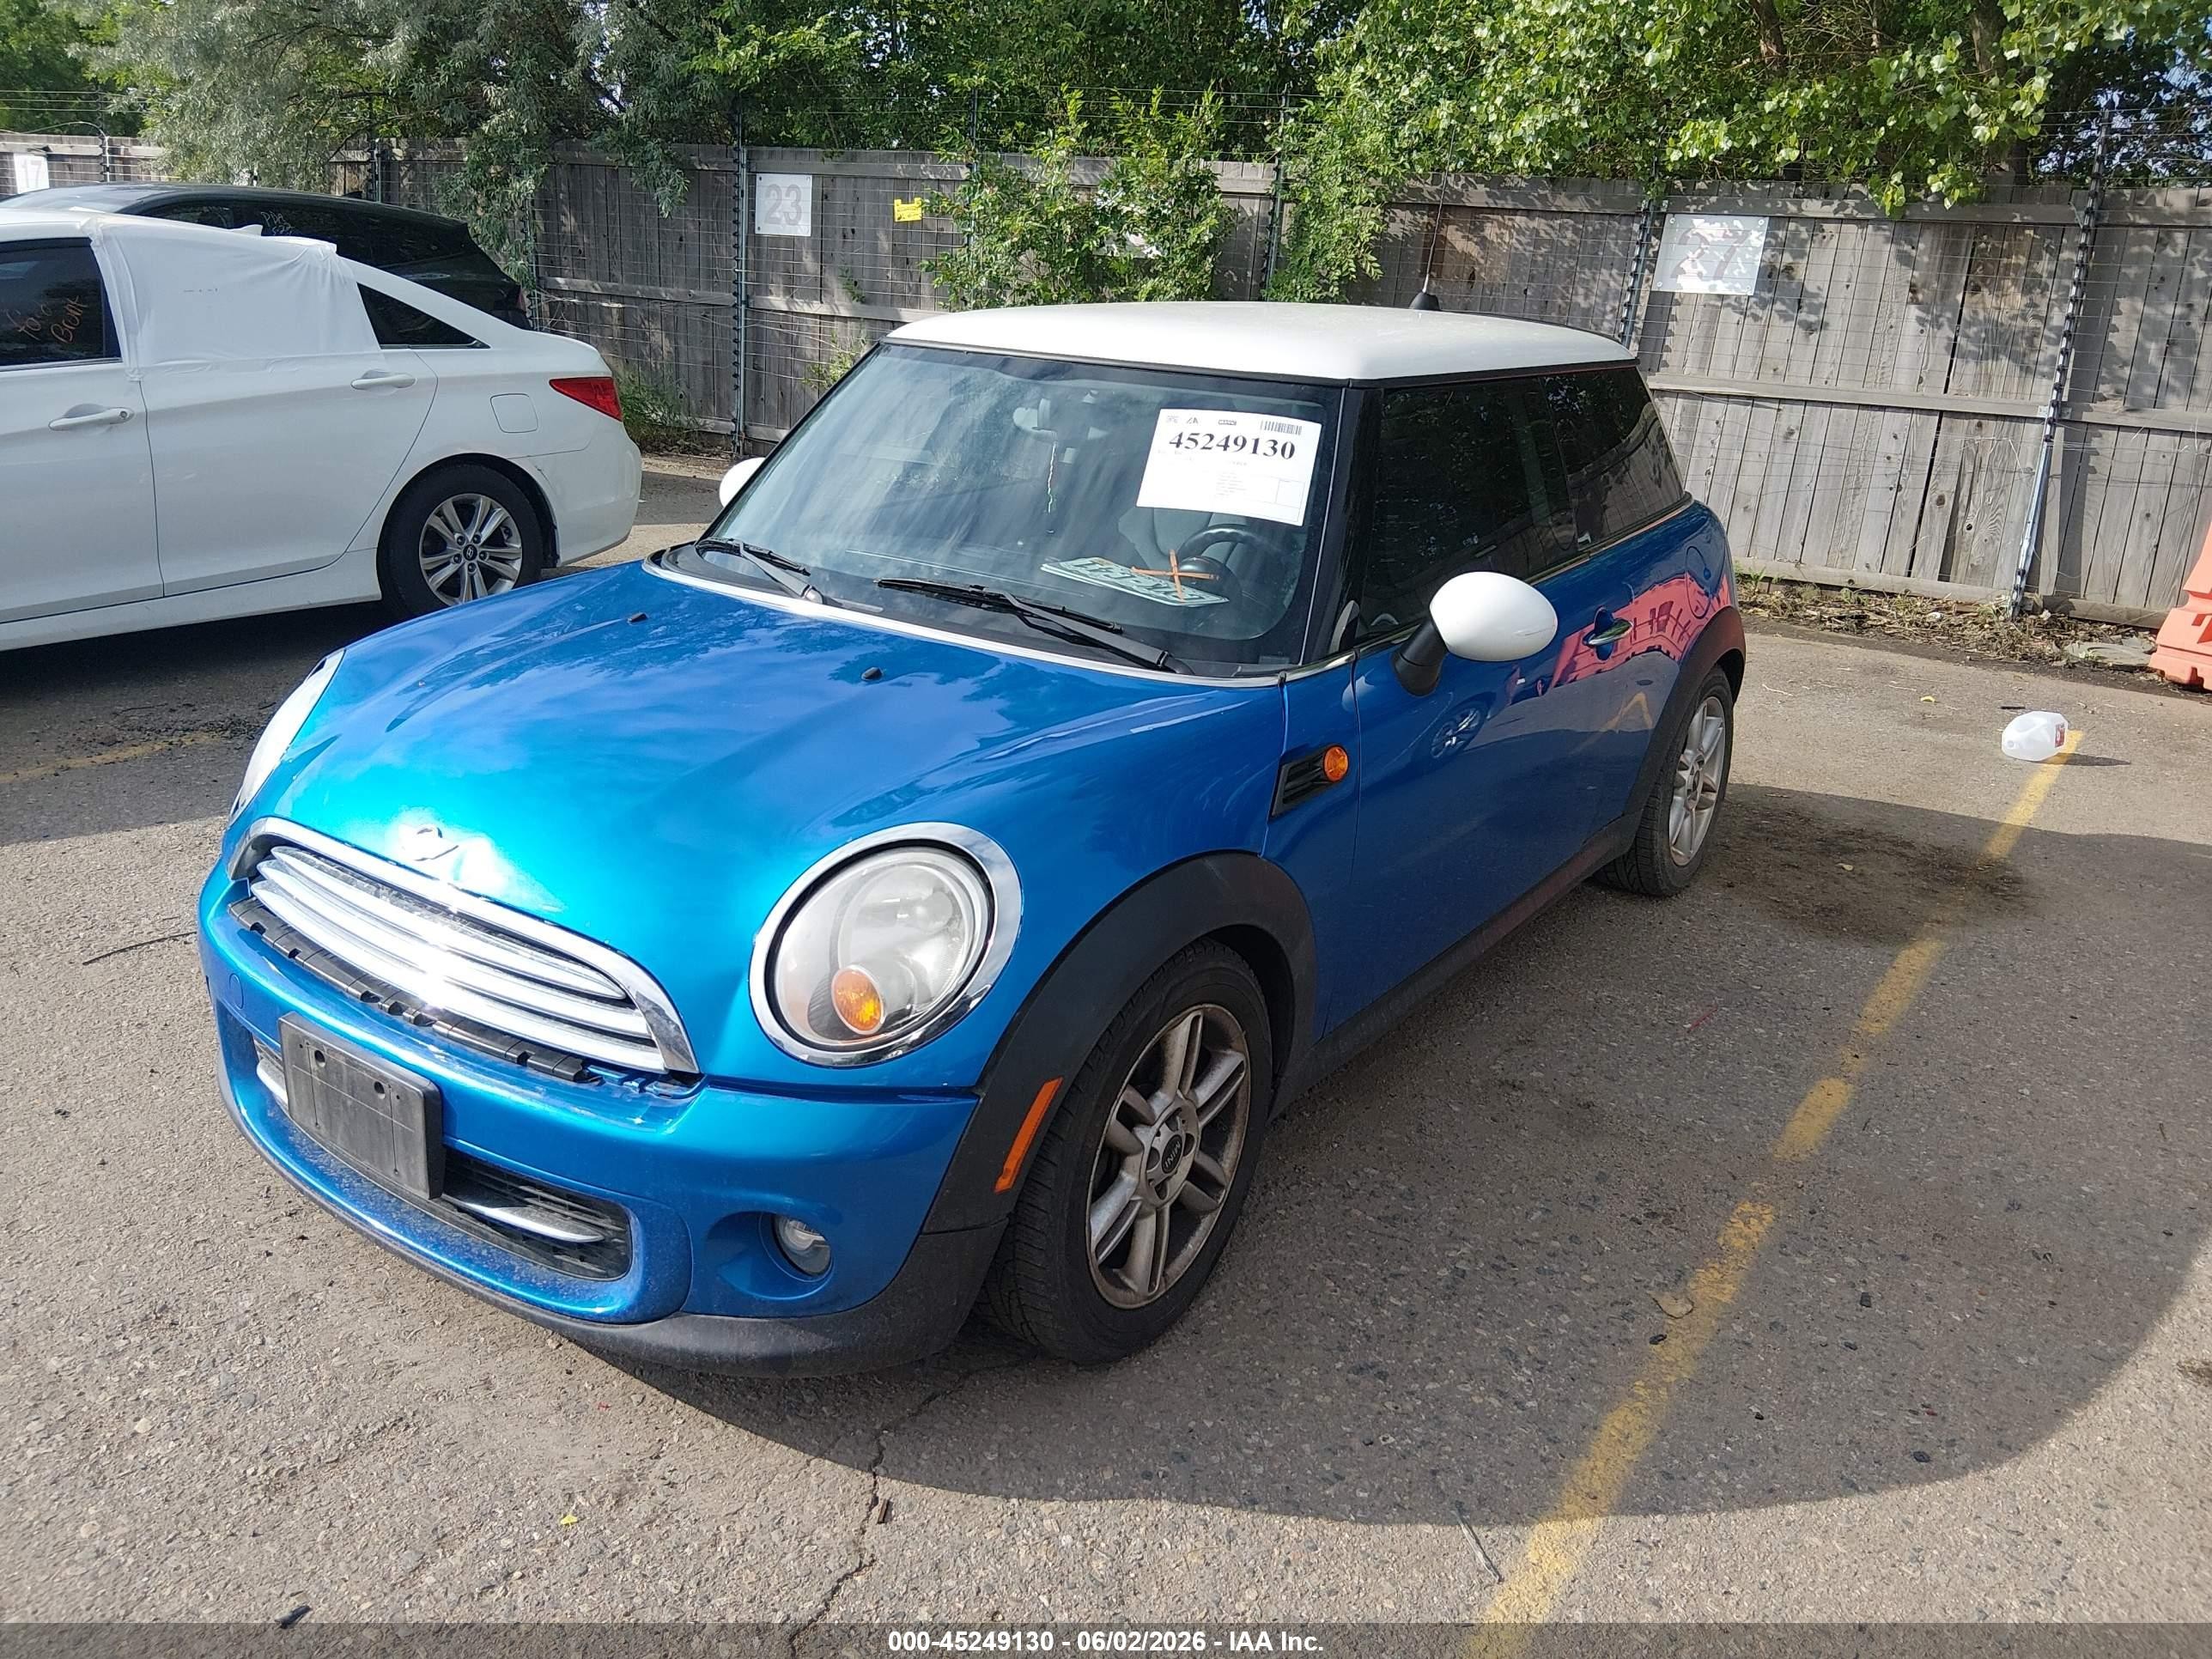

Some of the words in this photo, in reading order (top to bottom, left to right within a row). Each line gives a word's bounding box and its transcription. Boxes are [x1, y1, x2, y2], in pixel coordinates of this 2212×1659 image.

[763, 184, 803, 226] 23
[1670, 227, 1752, 282] 27
[1169, 431, 1296, 460] 45249130
[1164, 1140, 1182, 1169] MINI
